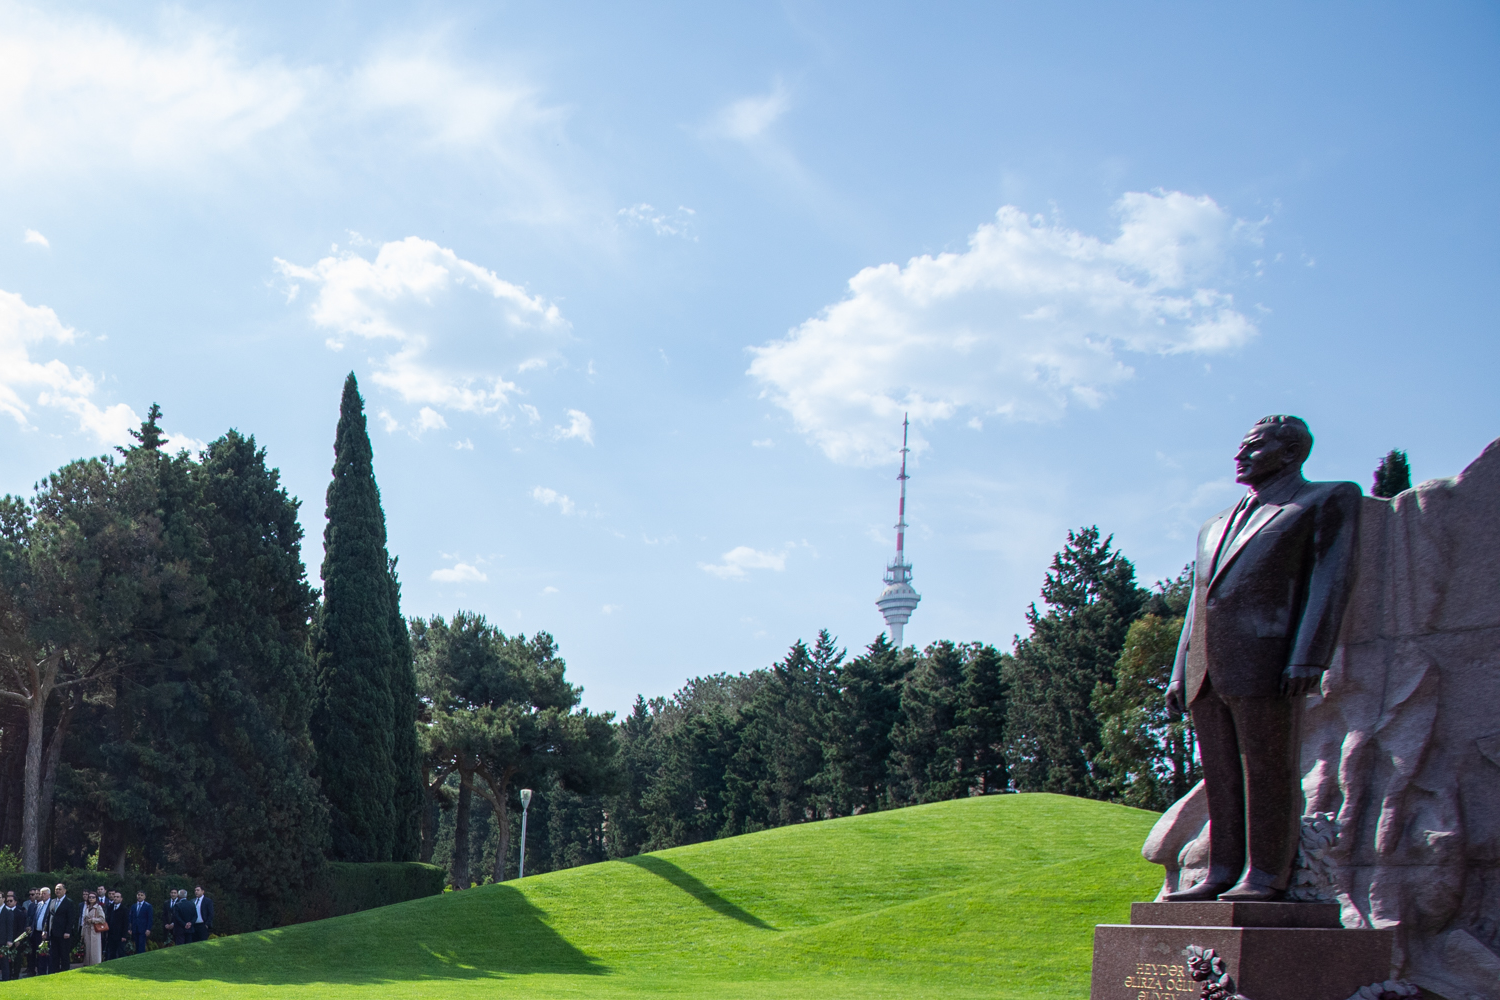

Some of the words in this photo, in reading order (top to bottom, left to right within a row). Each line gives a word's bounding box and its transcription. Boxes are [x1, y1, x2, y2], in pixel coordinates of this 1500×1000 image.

[1135, 963, 1185, 977] HEYDƏR
[1124, 974, 1164, 990] ƏLİRZA
[1165, 977, 1196, 992] OĞLU
